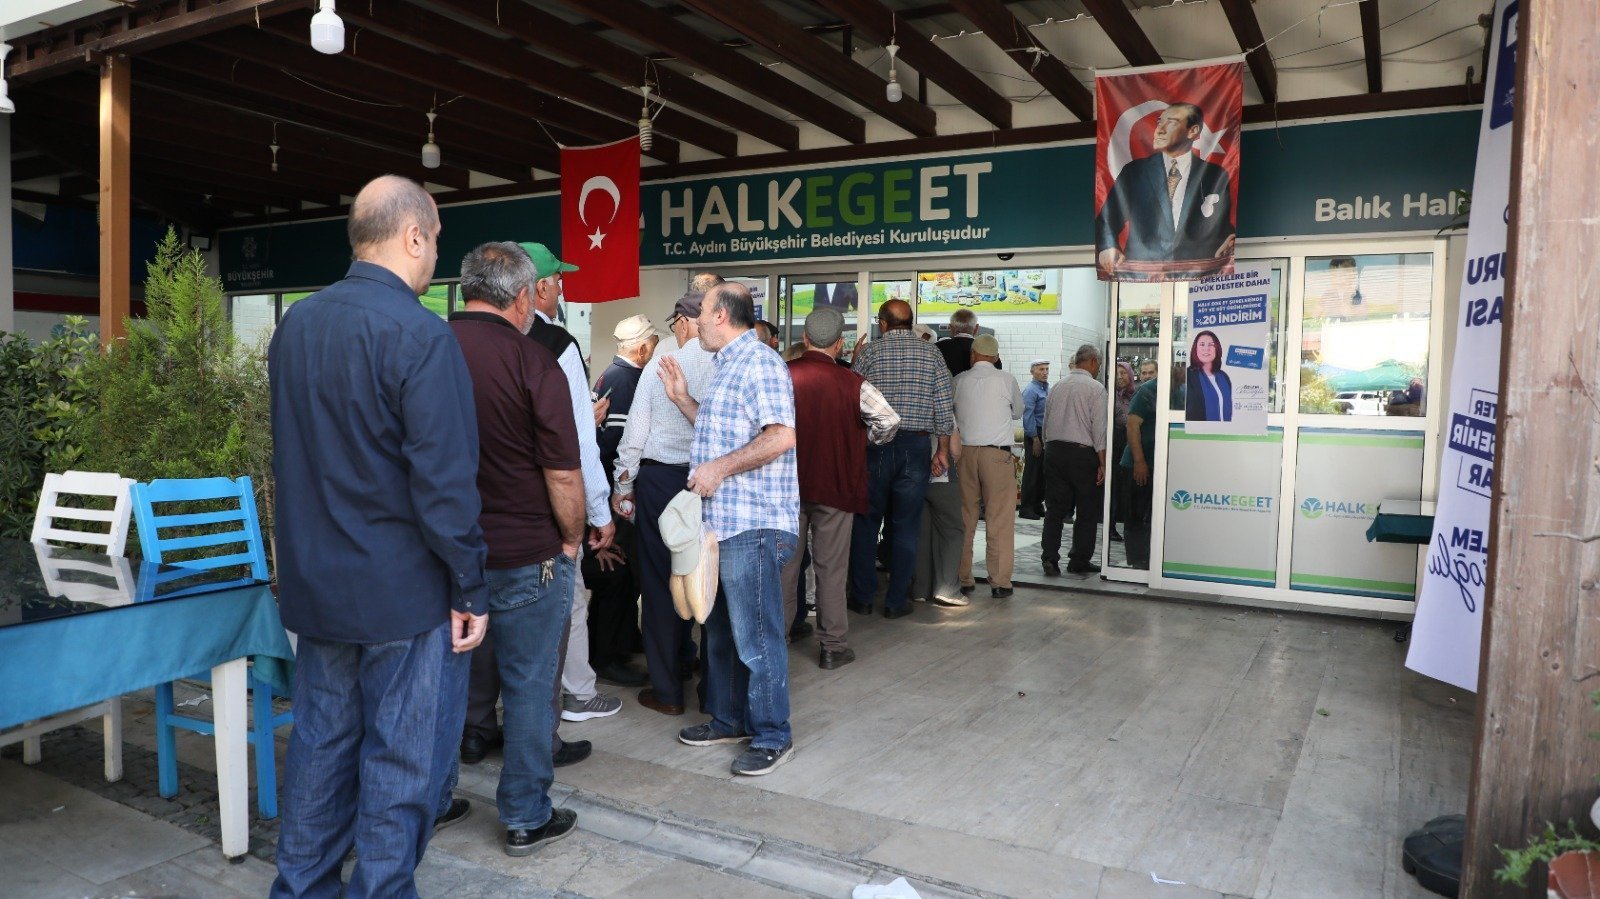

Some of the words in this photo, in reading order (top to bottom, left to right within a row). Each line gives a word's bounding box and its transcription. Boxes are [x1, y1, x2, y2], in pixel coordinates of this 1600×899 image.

[661, 161, 993, 238] HALKEGEET
[1315, 194, 1391, 222] Balık
[662, 242, 686, 256] T.C.
[689, 241, 727, 257] Aydın
[730, 233, 807, 254] Büyükşehir
[810, 229, 885, 249] Belediyesi
[890, 225, 990, 245] Kuruluşudur
[227, 267, 275, 282] BÜYÜKŞEHİR
[1189, 283, 1214, 293] BÜYÜK
[1215, 281, 1244, 291] DESTEK
[1245, 278, 1271, 287] DAHA!
[1218, 309, 1263, 324] İNDİRİM
[1193, 492, 1273, 508] HALKEGEET
[1325, 501, 1378, 516] HALKE
